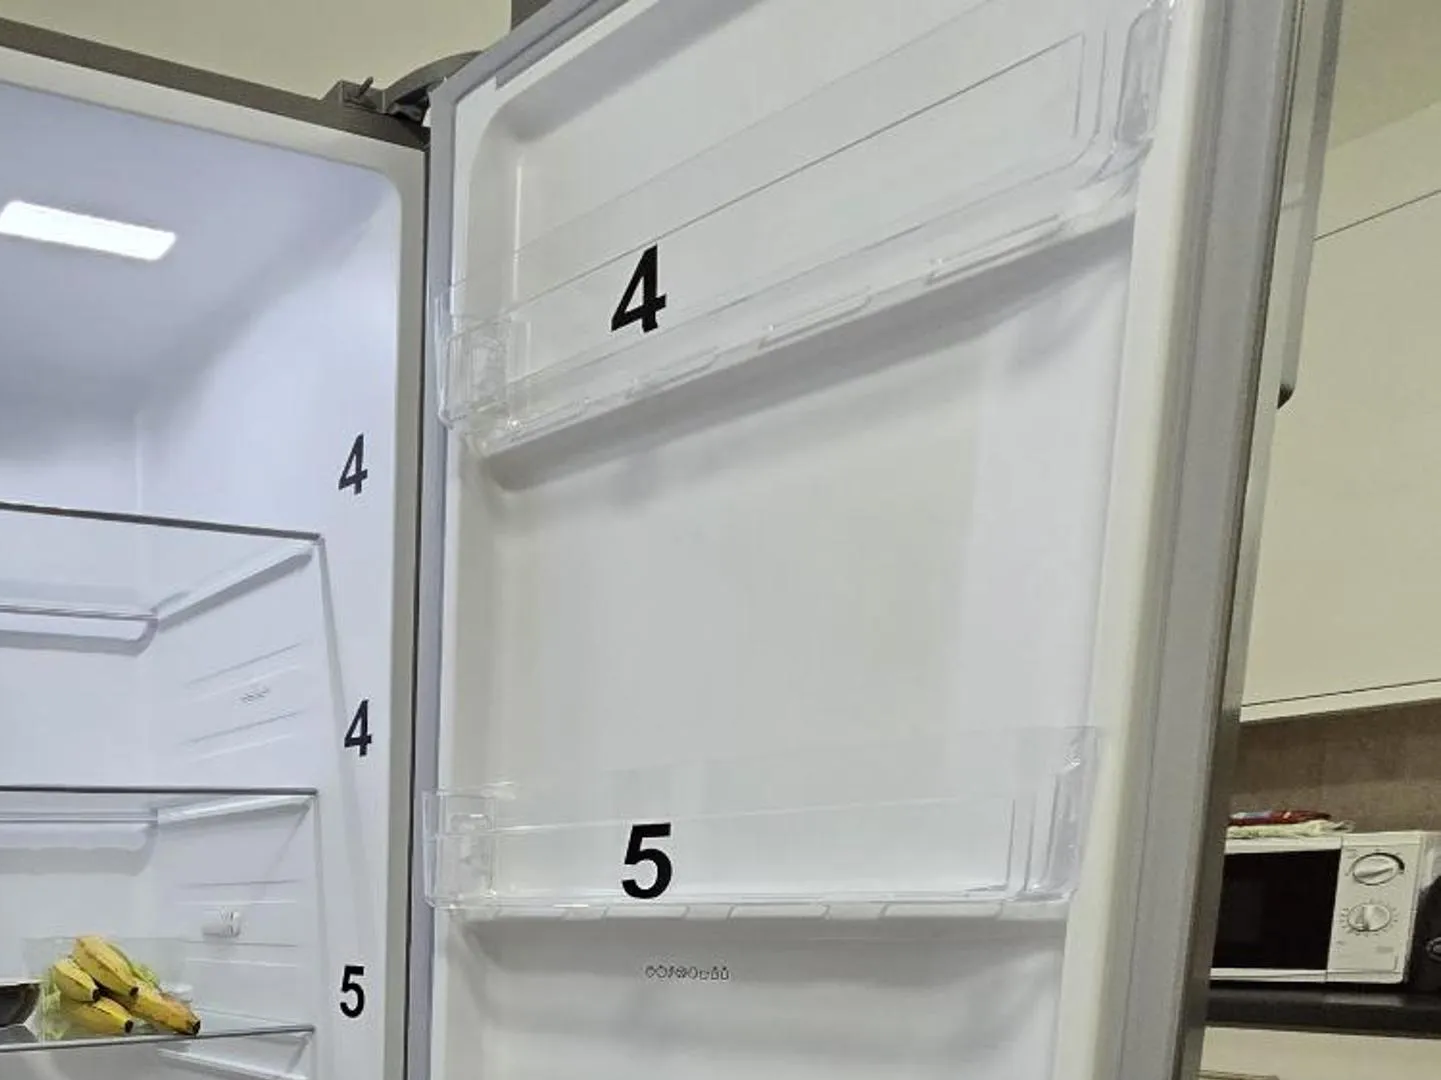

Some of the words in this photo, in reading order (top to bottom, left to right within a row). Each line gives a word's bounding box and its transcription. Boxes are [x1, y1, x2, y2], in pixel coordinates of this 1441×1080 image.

[611, 245, 666, 333] 4
[338, 433, 368, 495] 4
[344, 700, 372, 757] 4
[621, 822, 673, 900] 5
[339, 965, 366, 1019] 5
